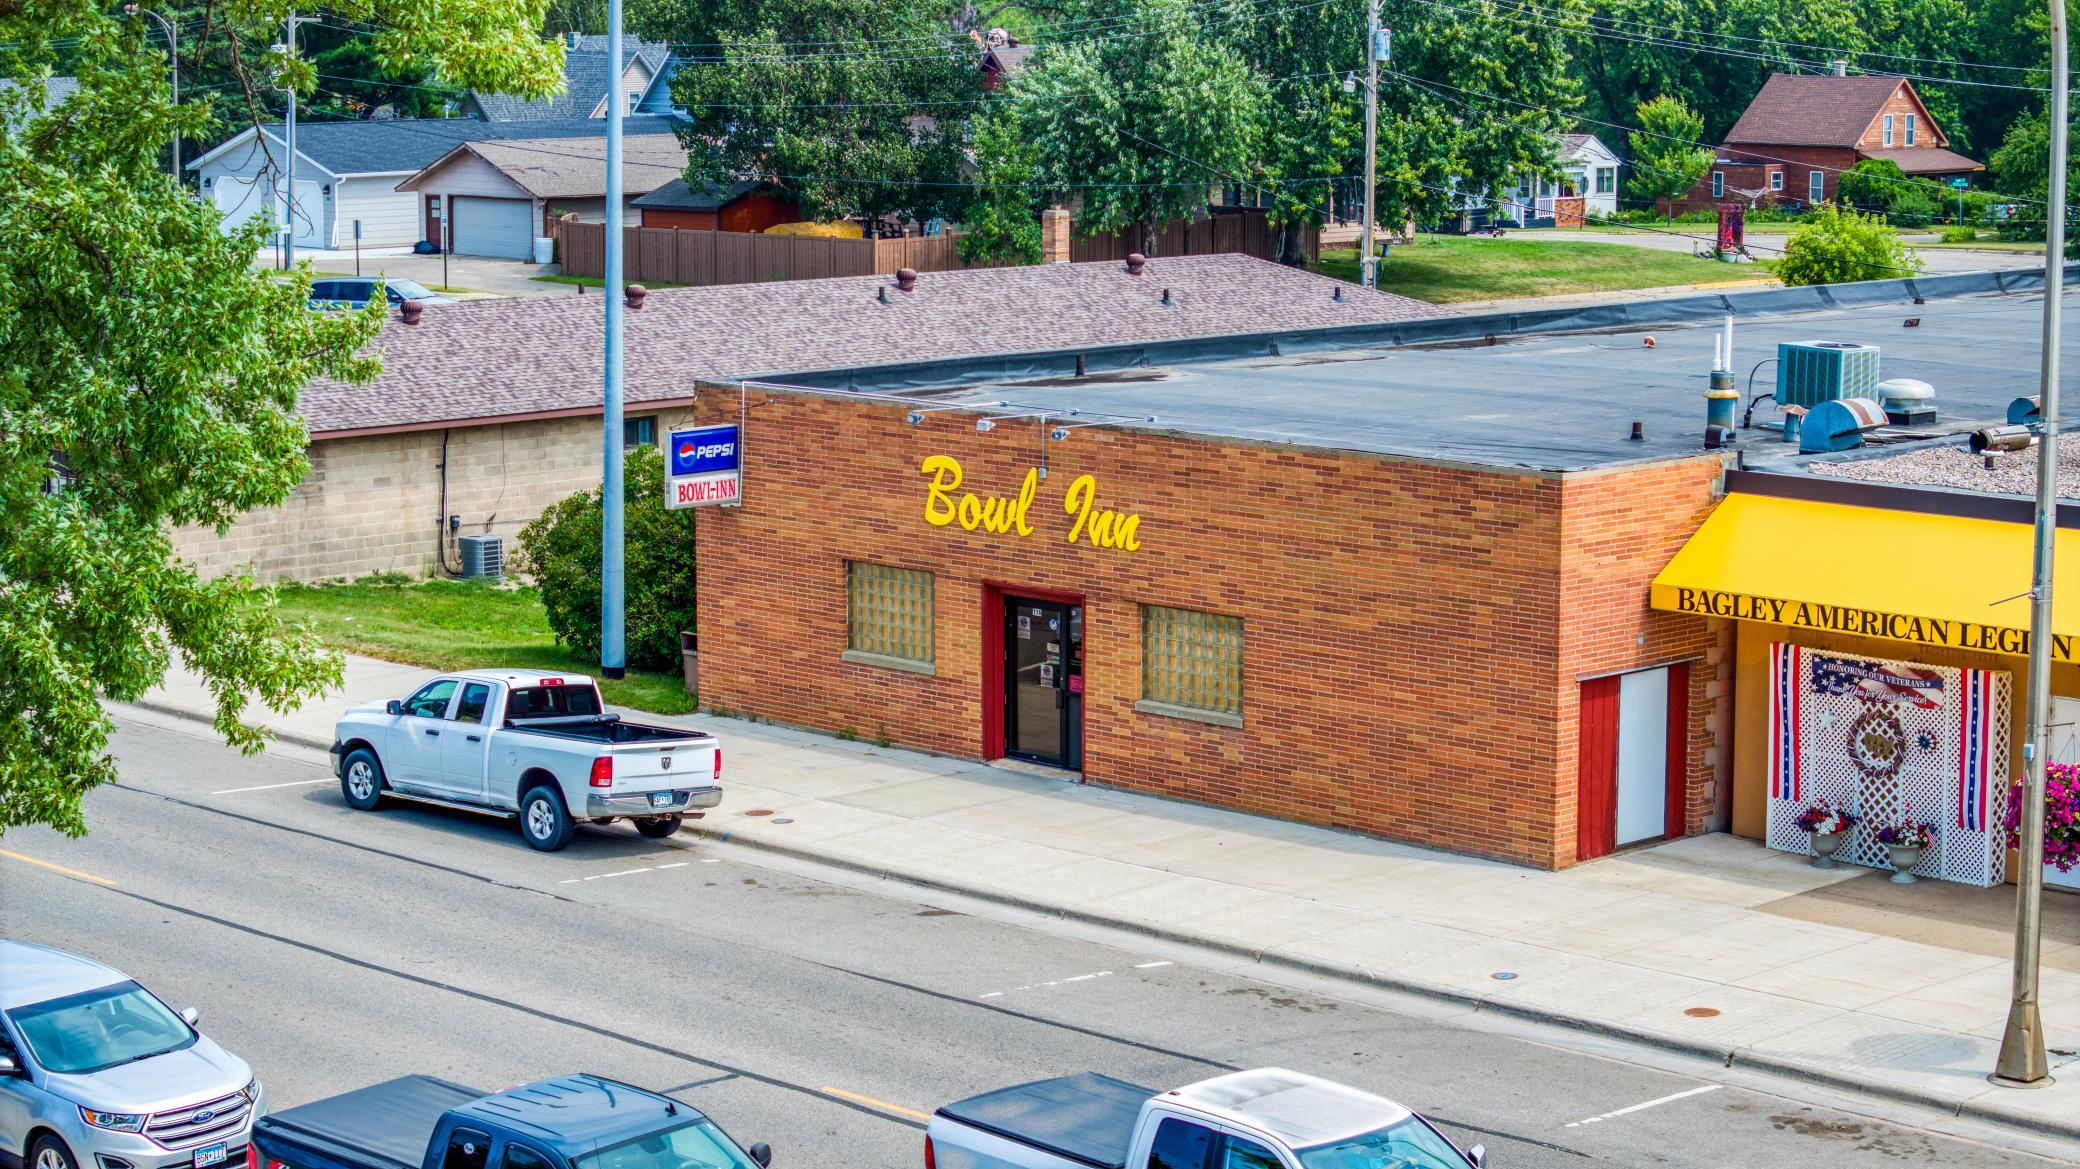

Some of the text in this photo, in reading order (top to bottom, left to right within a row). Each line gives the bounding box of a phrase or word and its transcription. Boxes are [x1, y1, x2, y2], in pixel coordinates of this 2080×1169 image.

[697, 443, 734, 459] PEPSI
[678, 478, 737, 503] BOWL-INN
[921, 455, 1141, 552] Bowl Inn
[1677, 587, 2074, 660] BAGLEY AMERICAN LEGIN
[1828, 663, 1925, 688] HONORING OUR VETERANS
